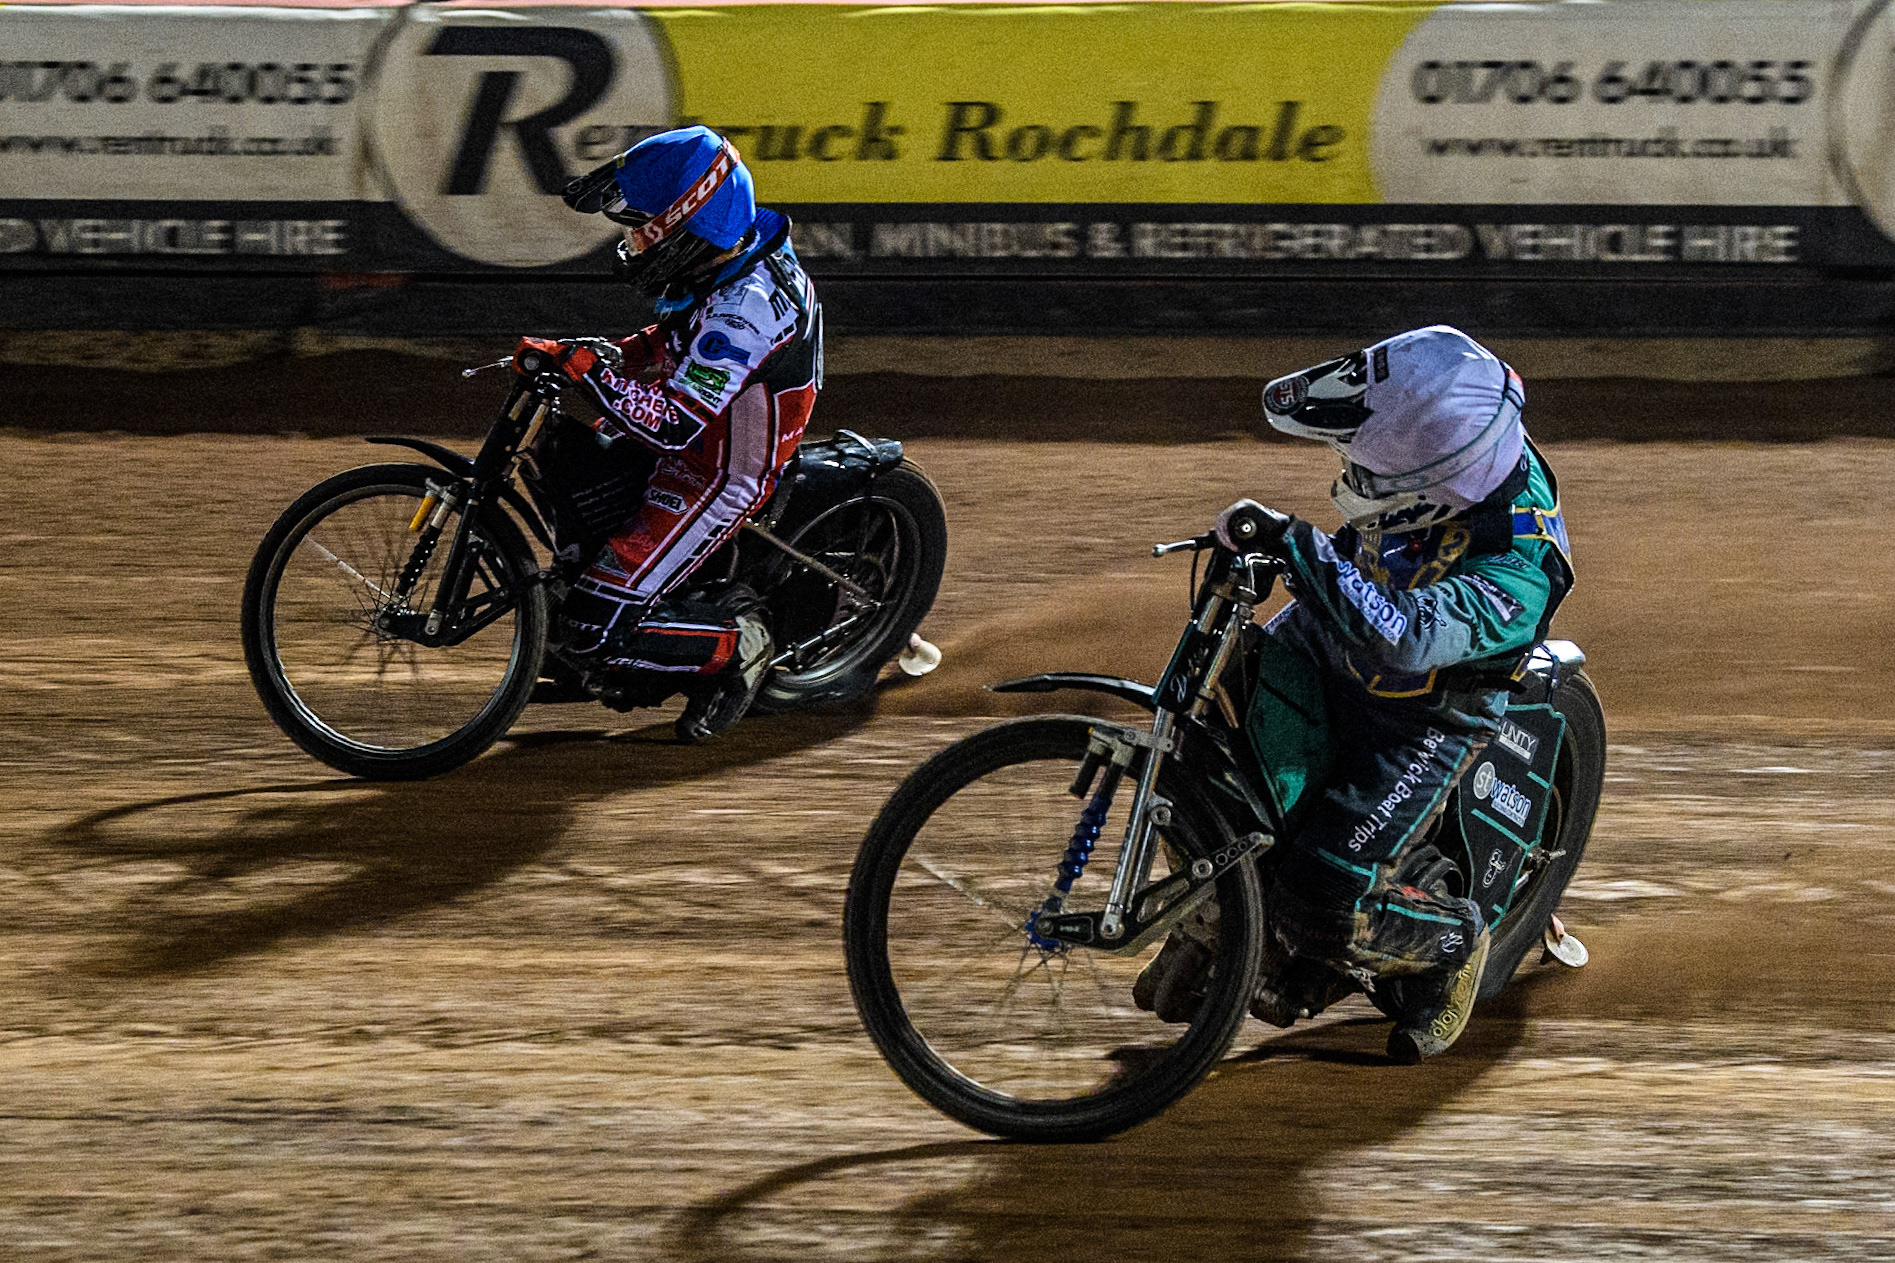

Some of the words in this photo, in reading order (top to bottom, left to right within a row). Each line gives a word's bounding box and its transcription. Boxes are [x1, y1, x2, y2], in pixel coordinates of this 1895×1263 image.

[148, 61, 357, 105] 640055
[1411, 59, 1580, 104] 01706
[1591, 59, 1816, 105] 640055
[932, 101, 1346, 163] Rochdale
[869, 220, 1079, 260] MINIBUS
[1086, 221, 1124, 260] &
[1131, 221, 1476, 261] REFRIGERATED
[1478, 223, 1680, 262] VEHICLE
[1682, 225, 1802, 263] HIRE
[1336, 560, 1407, 637] watson
[1402, 726, 1446, 785] Berwick
[1501, 720, 1537, 752] UNITY
[1376, 780, 1414, 819] Boat
[1347, 812, 1389, 853] Trips
